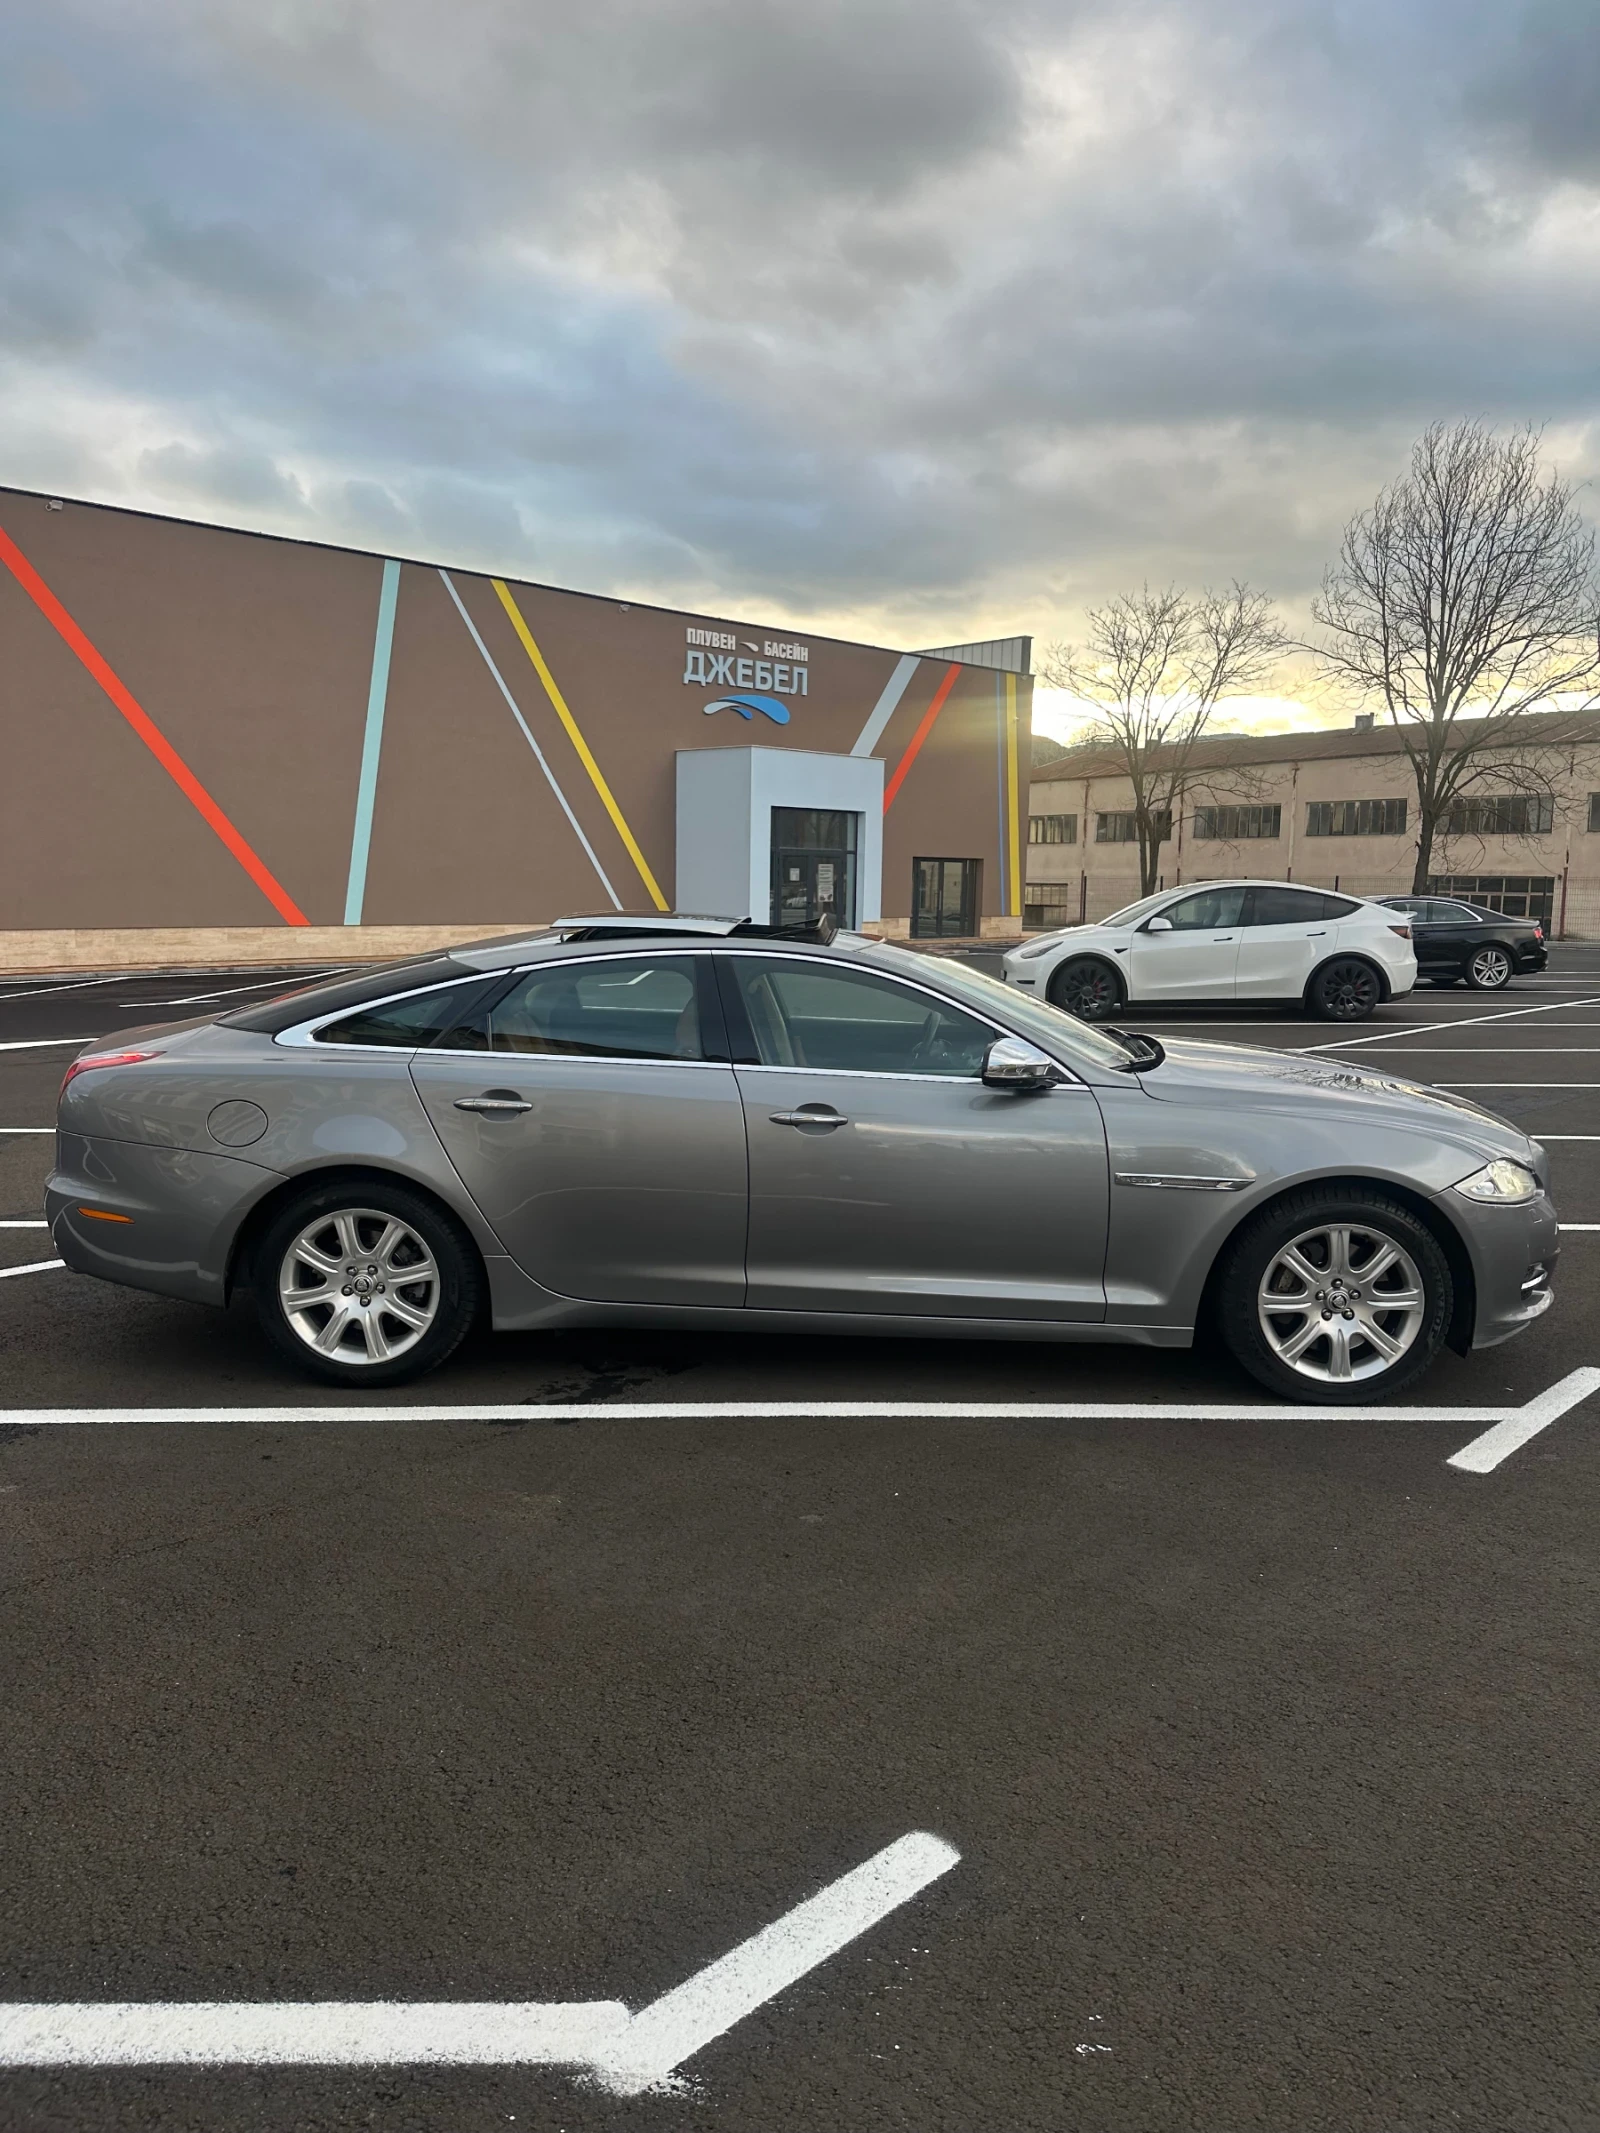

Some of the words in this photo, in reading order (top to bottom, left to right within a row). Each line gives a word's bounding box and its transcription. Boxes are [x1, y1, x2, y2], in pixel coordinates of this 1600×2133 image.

[686, 627, 736, 650] ПЛУВЕН
[764, 640, 809, 662] БАСЕЙН
[683, 650, 808, 696] ДЖЕБЕЛ
